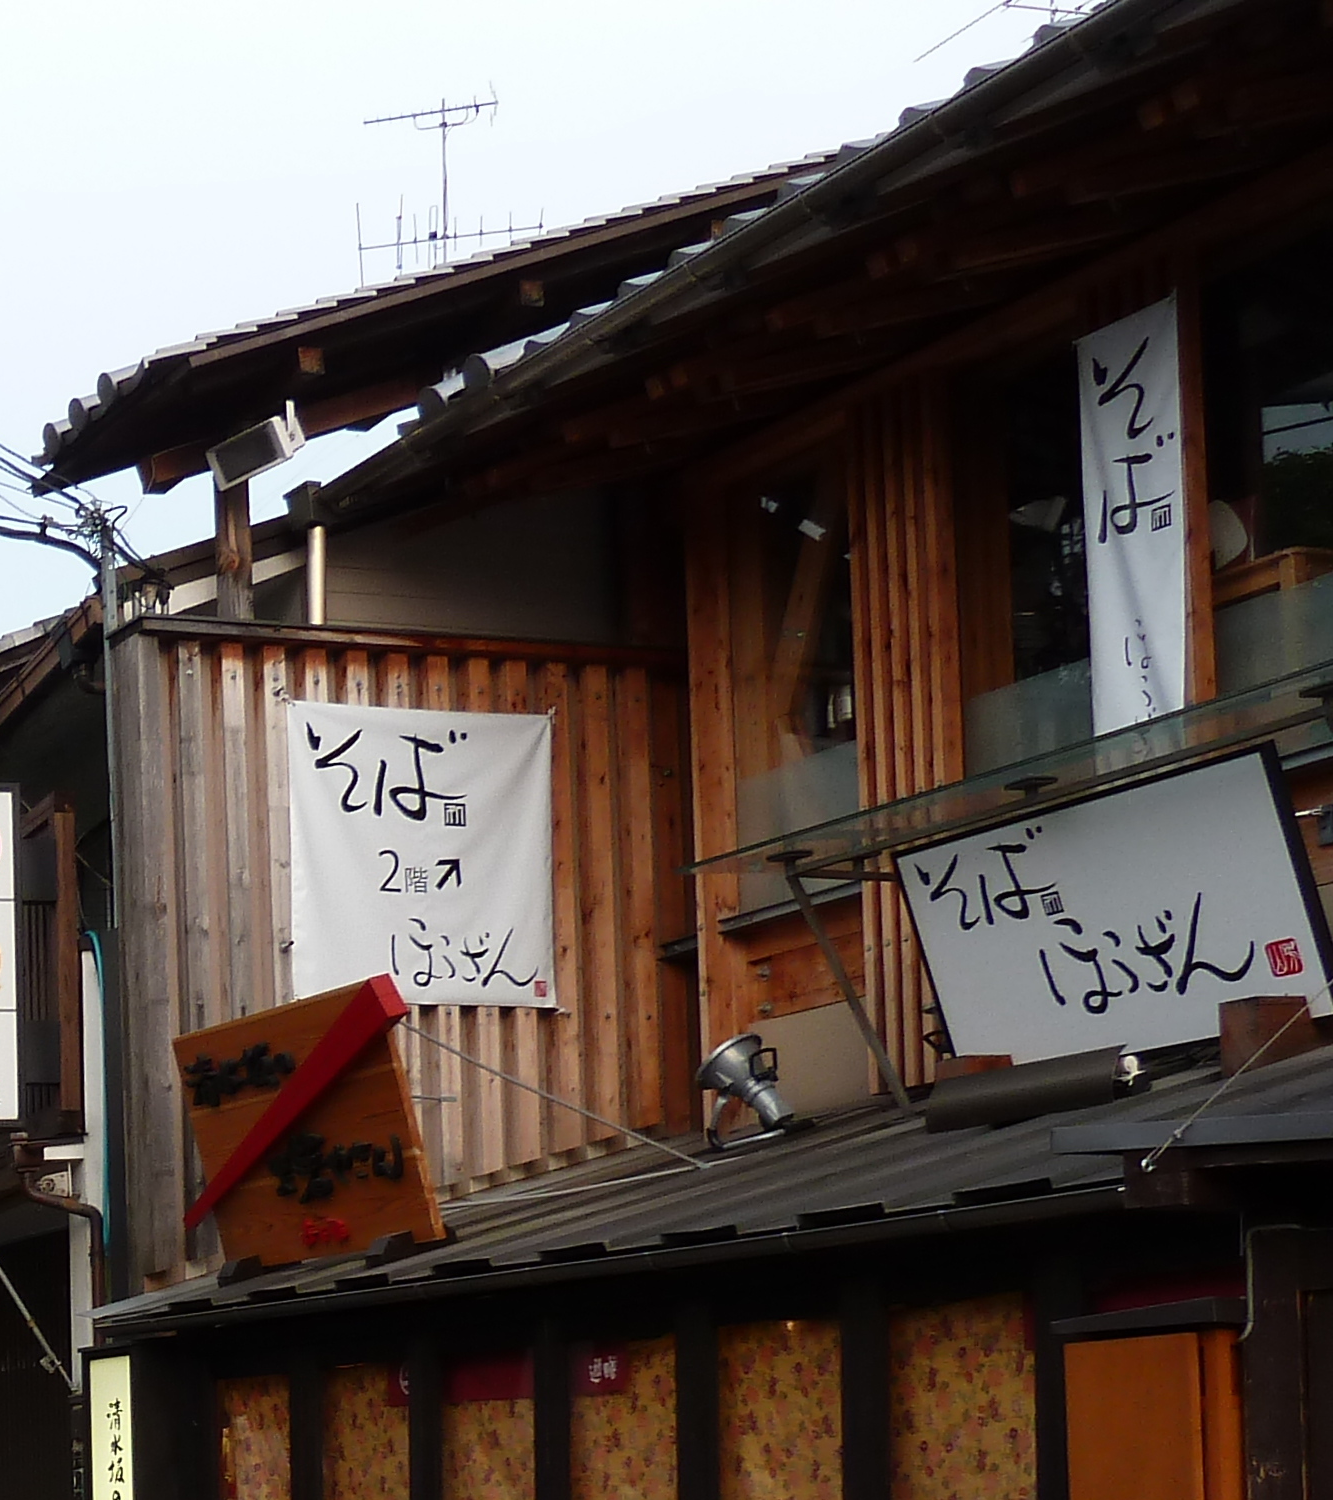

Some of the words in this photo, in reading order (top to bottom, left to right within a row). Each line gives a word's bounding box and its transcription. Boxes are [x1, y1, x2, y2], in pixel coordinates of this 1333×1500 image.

[306, 721, 467, 821] そば
[378, 849, 429, 894] 2階
[914, 825, 1058, 931] そば
[391, 917, 539, 988] ほうざん
[1038, 889, 1256, 1015] ほうざん
